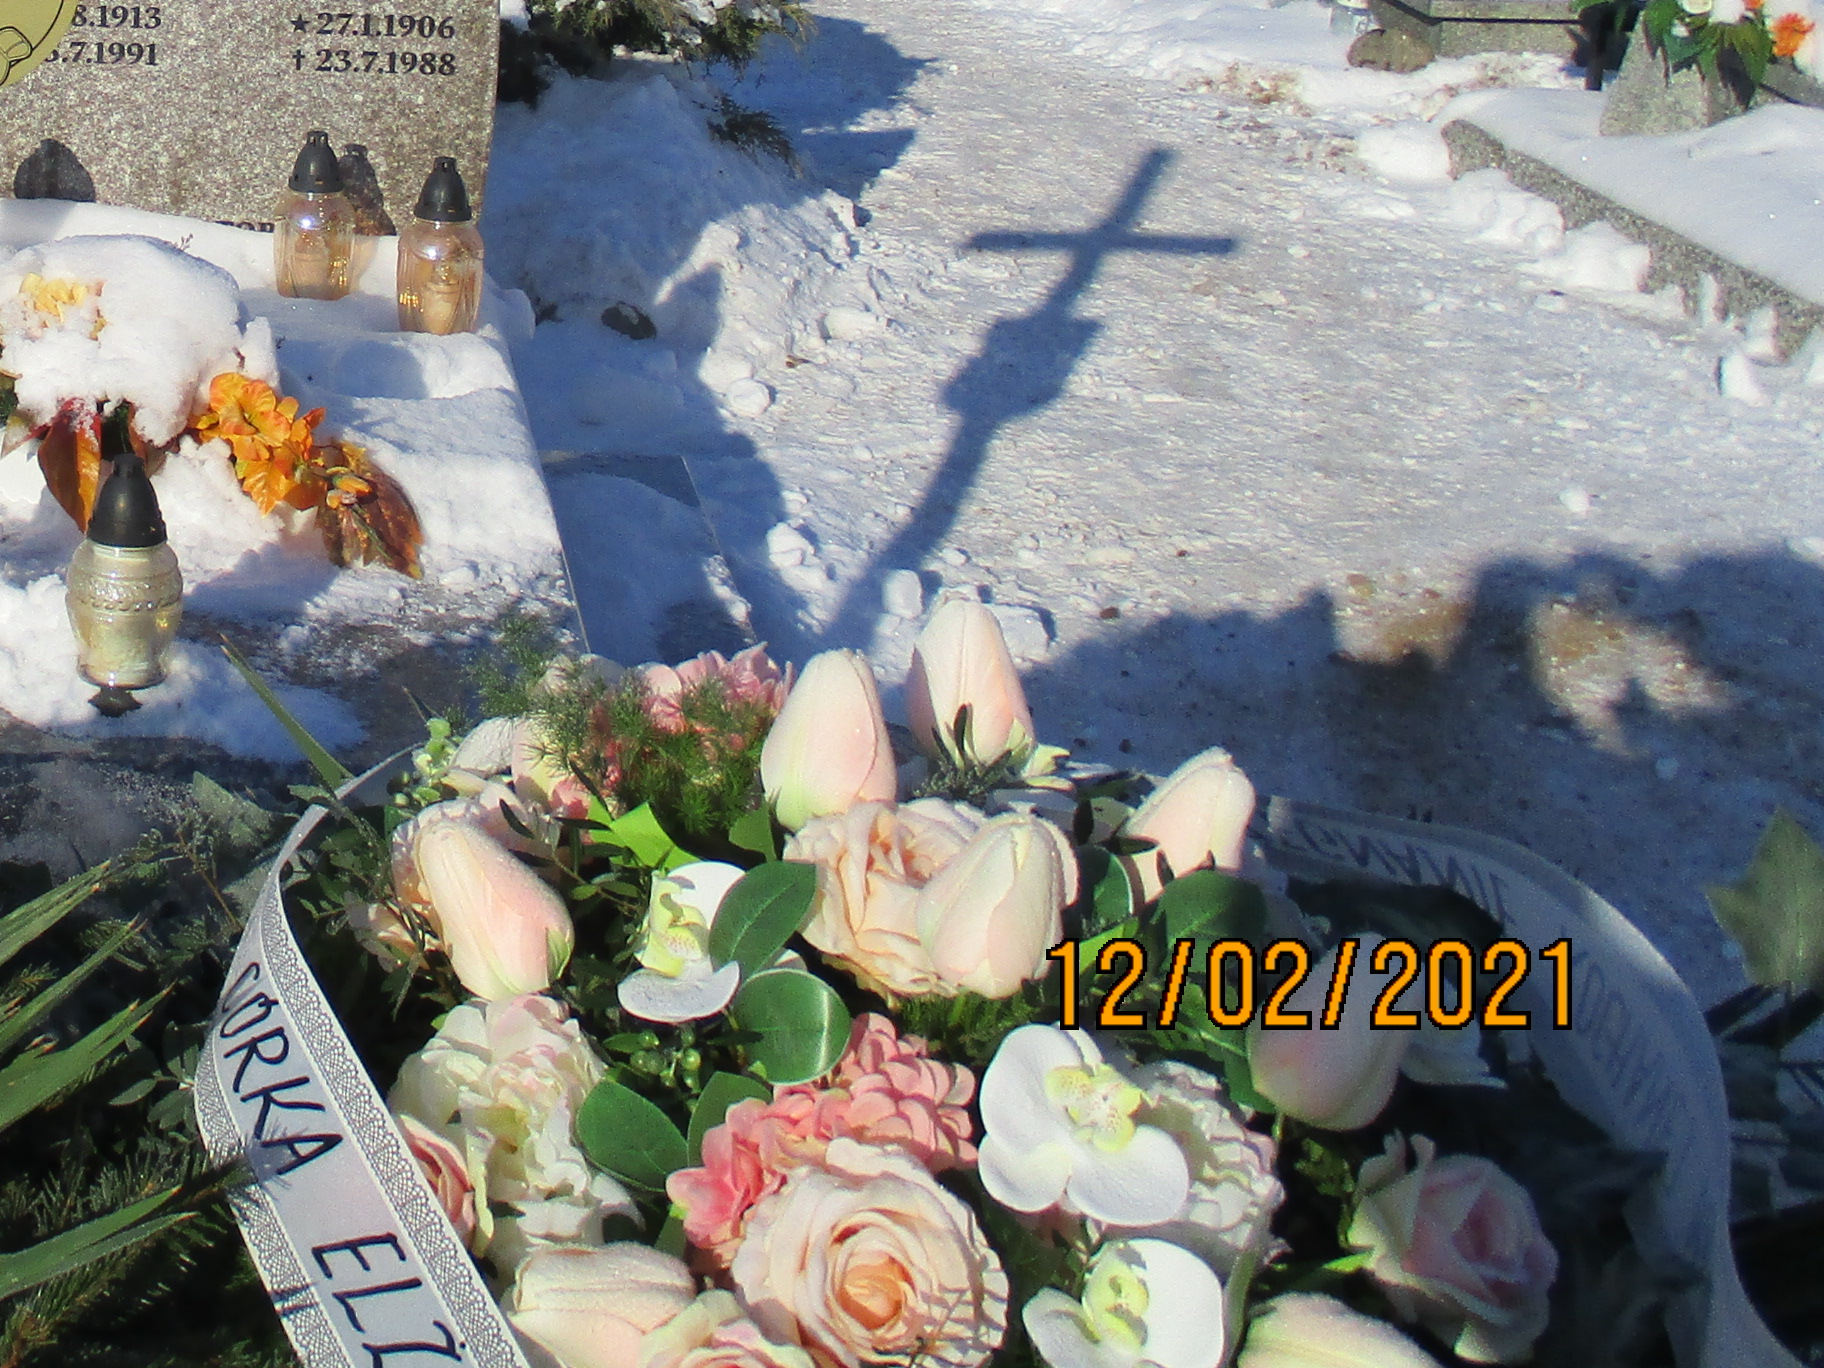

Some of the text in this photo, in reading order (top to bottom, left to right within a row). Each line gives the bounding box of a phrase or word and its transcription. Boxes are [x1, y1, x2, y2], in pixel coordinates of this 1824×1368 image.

[315, 11, 455, 39] 27.1.1906
[315, 49, 456, 76] 23.7.1988
[219, 961, 344, 1178] CÓRKA
